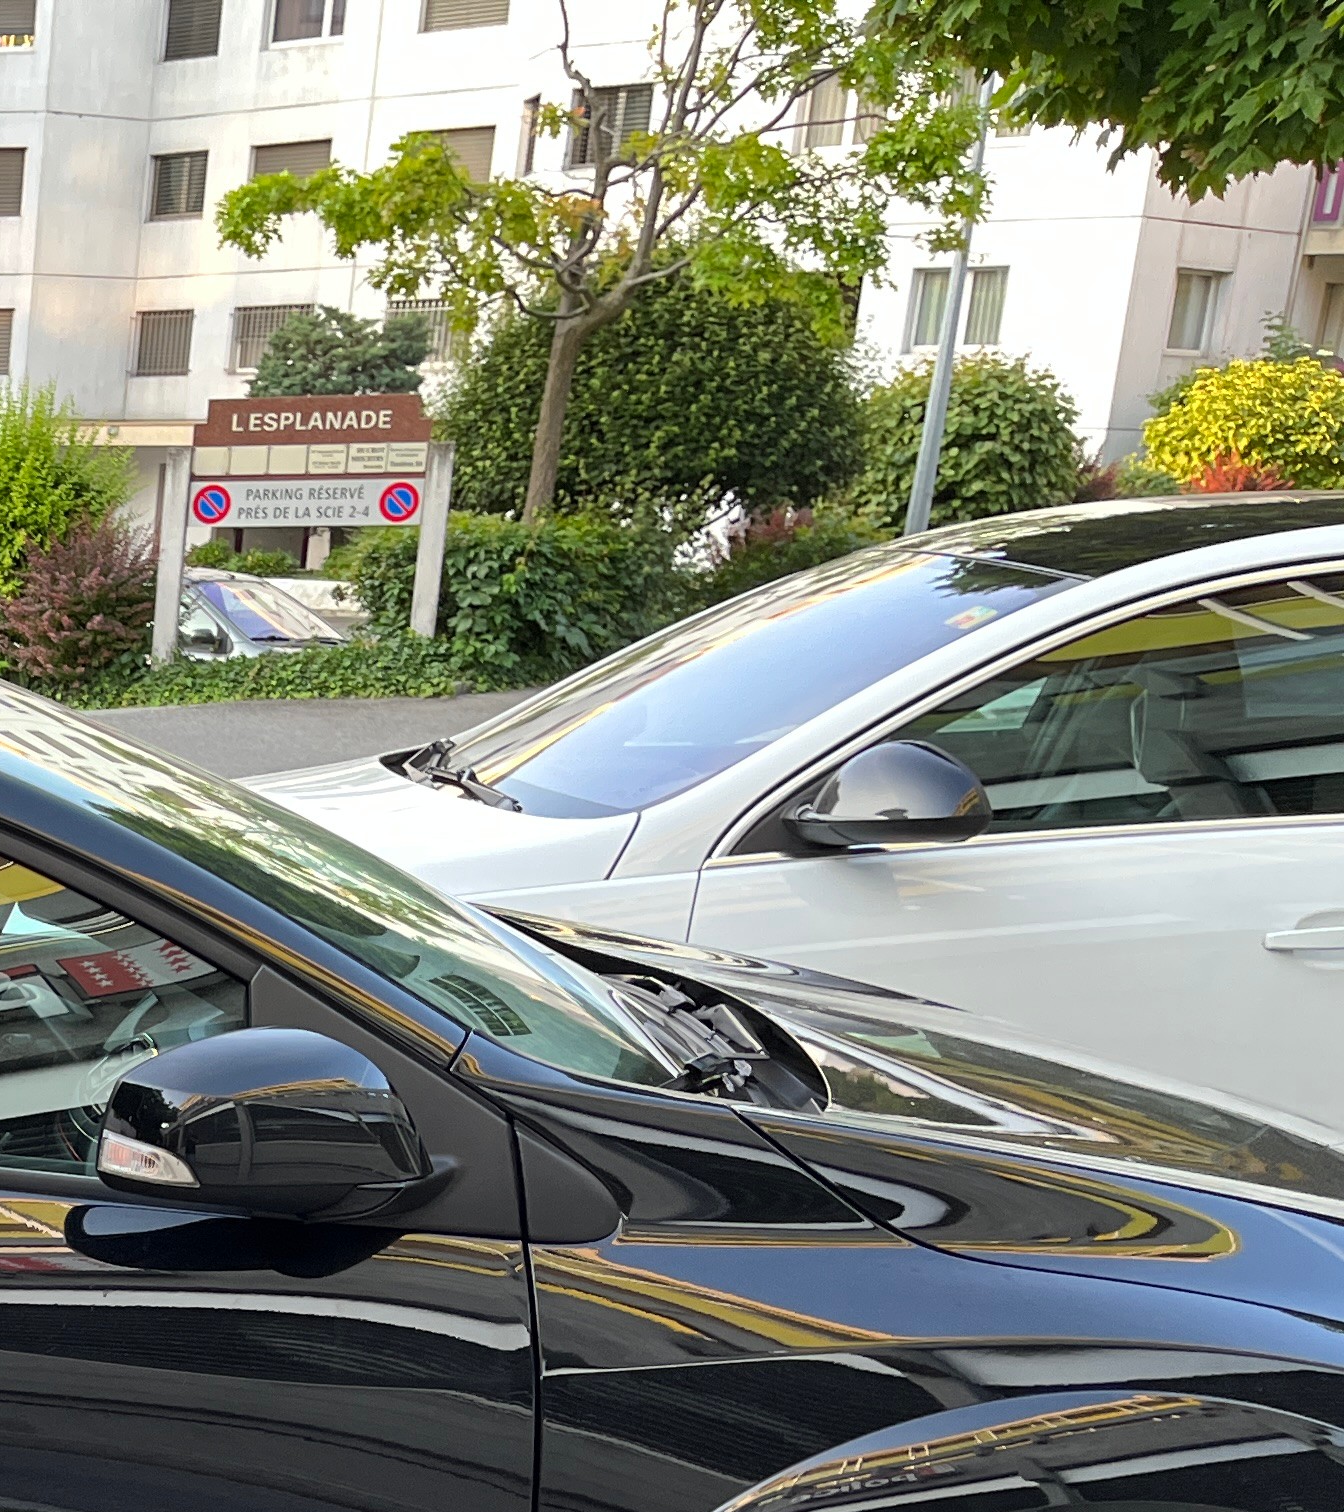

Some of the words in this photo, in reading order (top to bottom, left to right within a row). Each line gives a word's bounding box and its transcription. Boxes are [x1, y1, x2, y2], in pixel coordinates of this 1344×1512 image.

[245, 487, 304, 501] PARKING
[308, 484, 365, 500] RÉSERVÉ
[273, 506, 290, 519] DE
[295, 506, 311, 518] LA
[316, 505, 344, 518] SCIE
[349, 505, 370, 518] 2-4
